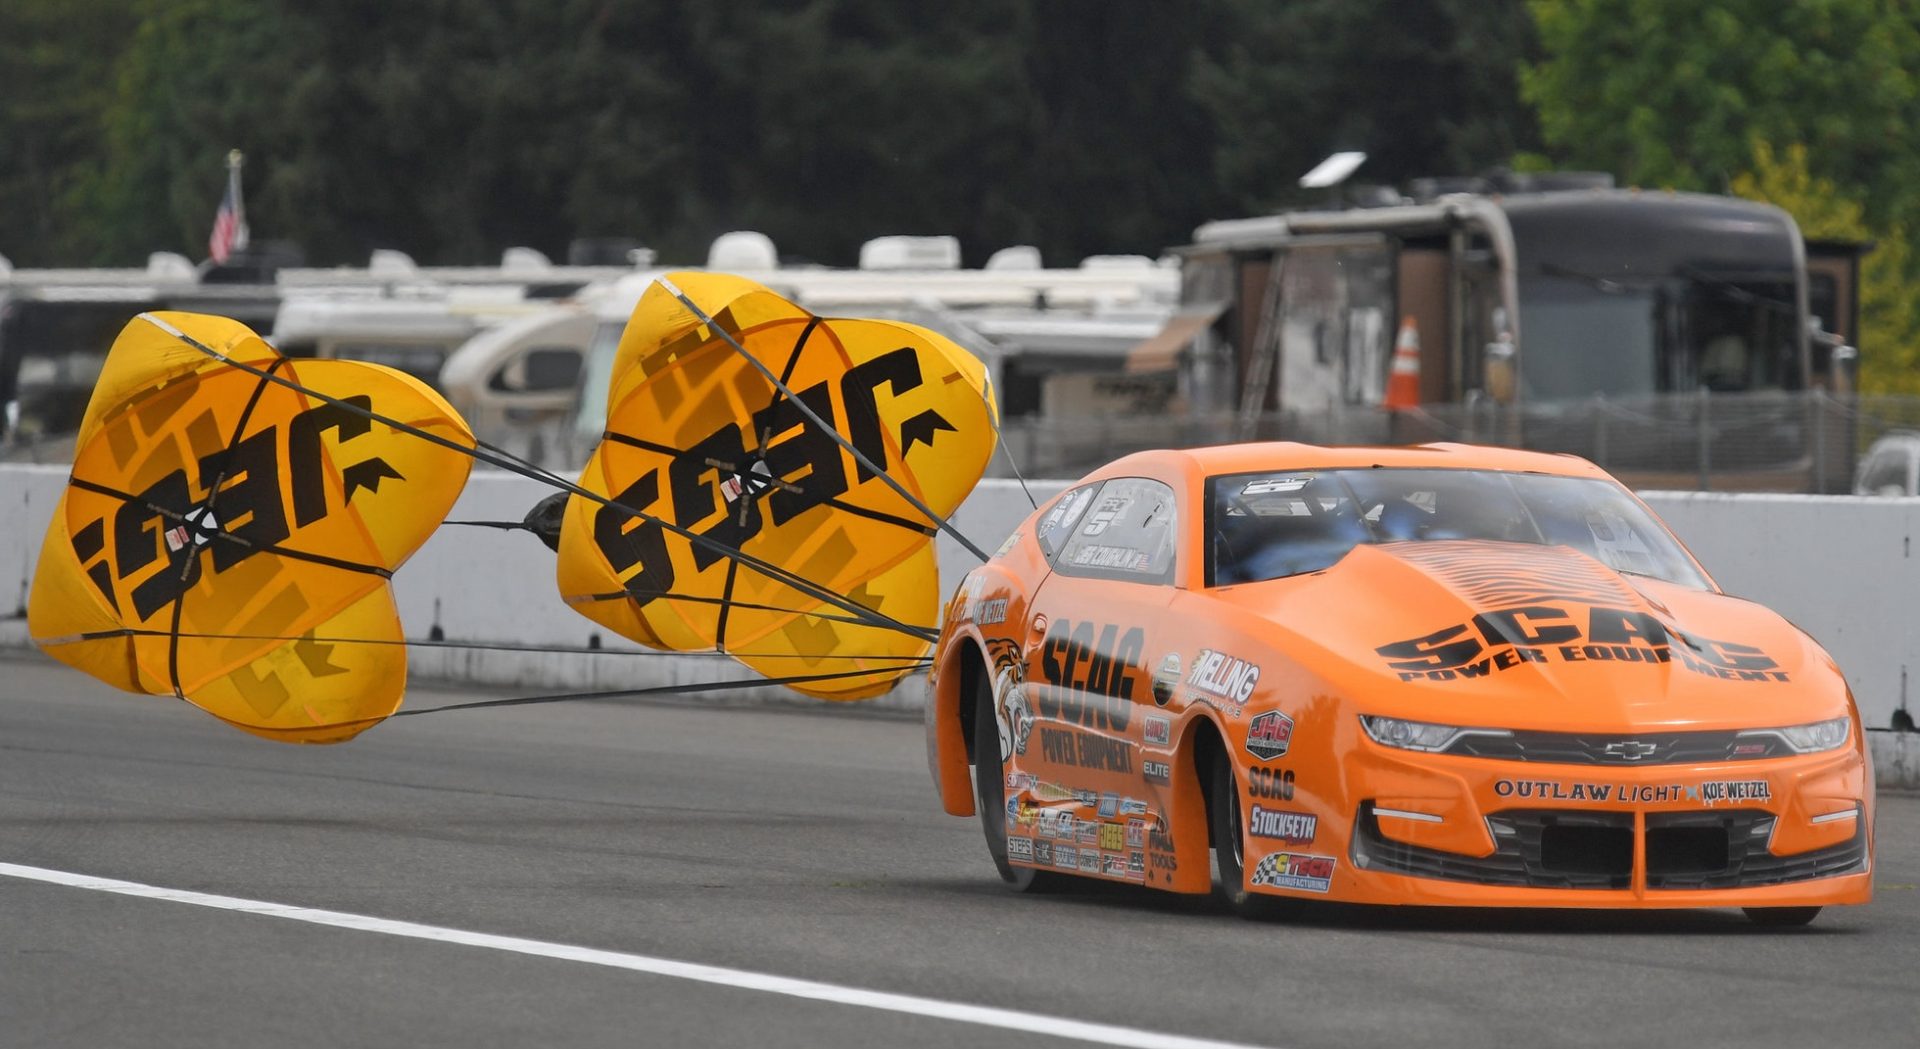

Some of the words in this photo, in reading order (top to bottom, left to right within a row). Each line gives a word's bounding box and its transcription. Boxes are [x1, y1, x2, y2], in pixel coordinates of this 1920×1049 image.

[1375, 606, 1780, 672] SCAG
[1039, 618, 1145, 732] SCAG
[1187, 649, 1260, 704] MELLING
[1396, 647, 1550, 684] POWER
[1559, 645, 1792, 684] EQUIPMENT
[1250, 713, 1291, 741] JHG
[1040, 728, 1077, 767] POWER
[1077, 732, 1134, 775] EQUIPMENT
[1143, 762, 1169, 777] ELITE
[1248, 766, 1296, 802] SCAG
[1494, 780, 1612, 801] OUTLAW
[1618, 785, 1683, 802] LIGHT
[1702, 781, 1725, 801] KOE
[1726, 781, 1771, 800] WETZEL
[1250, 805, 1317, 840] STOCKSETH
